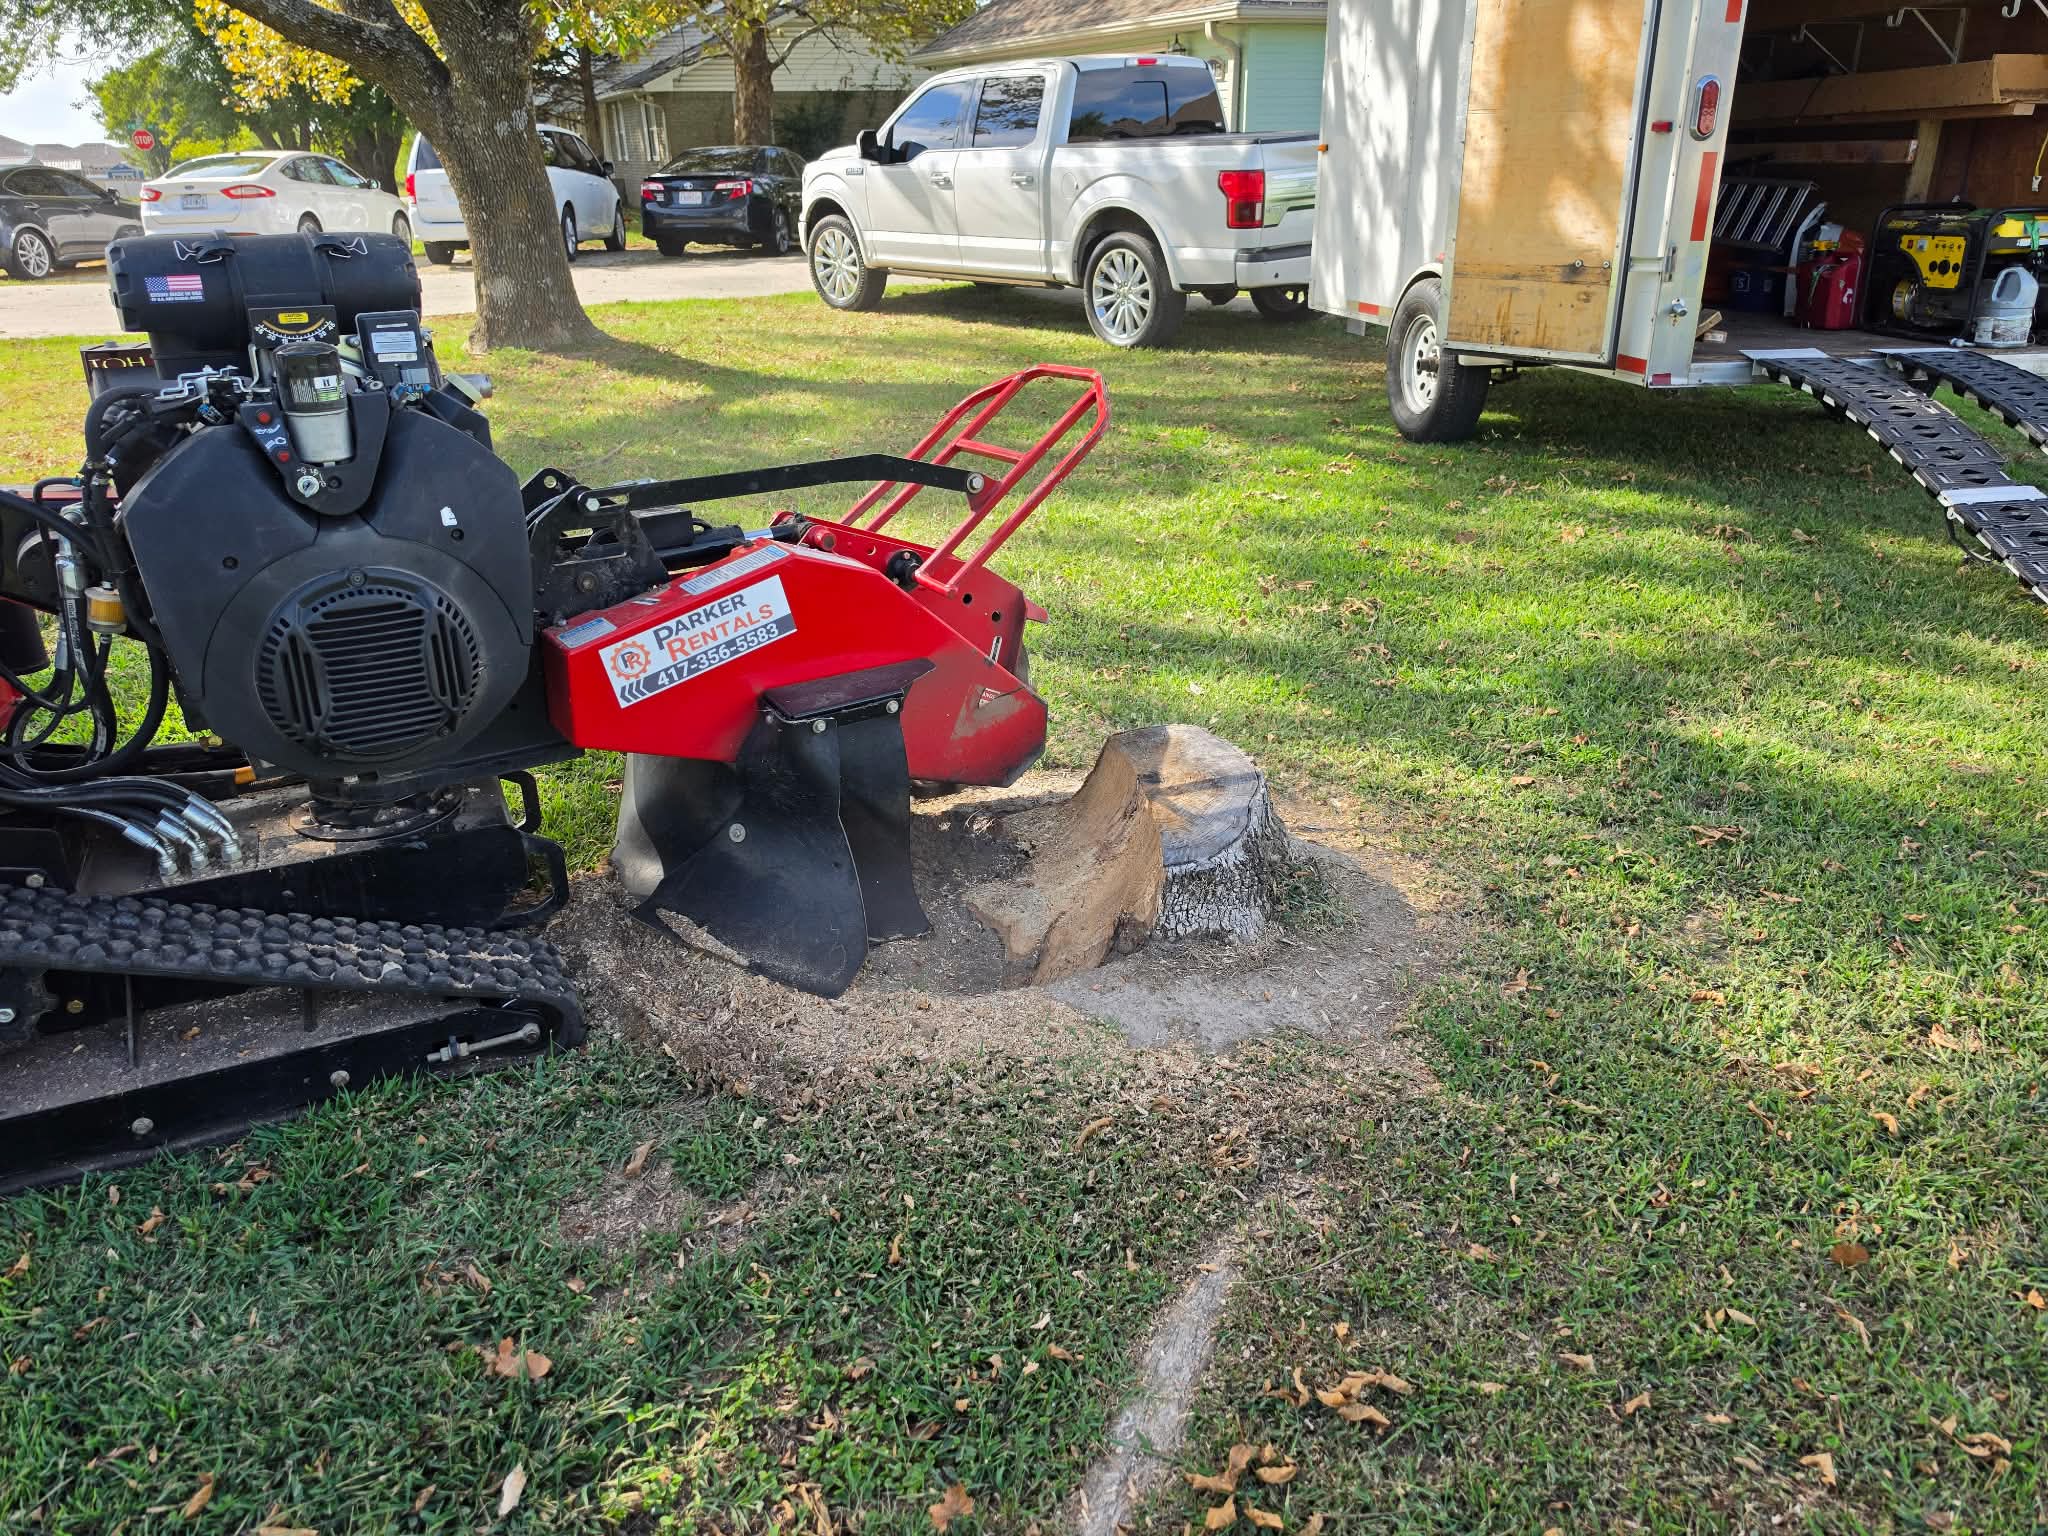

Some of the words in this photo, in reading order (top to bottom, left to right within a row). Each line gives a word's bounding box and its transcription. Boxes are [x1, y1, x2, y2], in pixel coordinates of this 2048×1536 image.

[134, 135, 152, 145] STOP
[652, 593, 747, 650] PARKER
[666, 604, 773, 662] RENTALS
[657, 623, 779, 686] 417-356-5583
